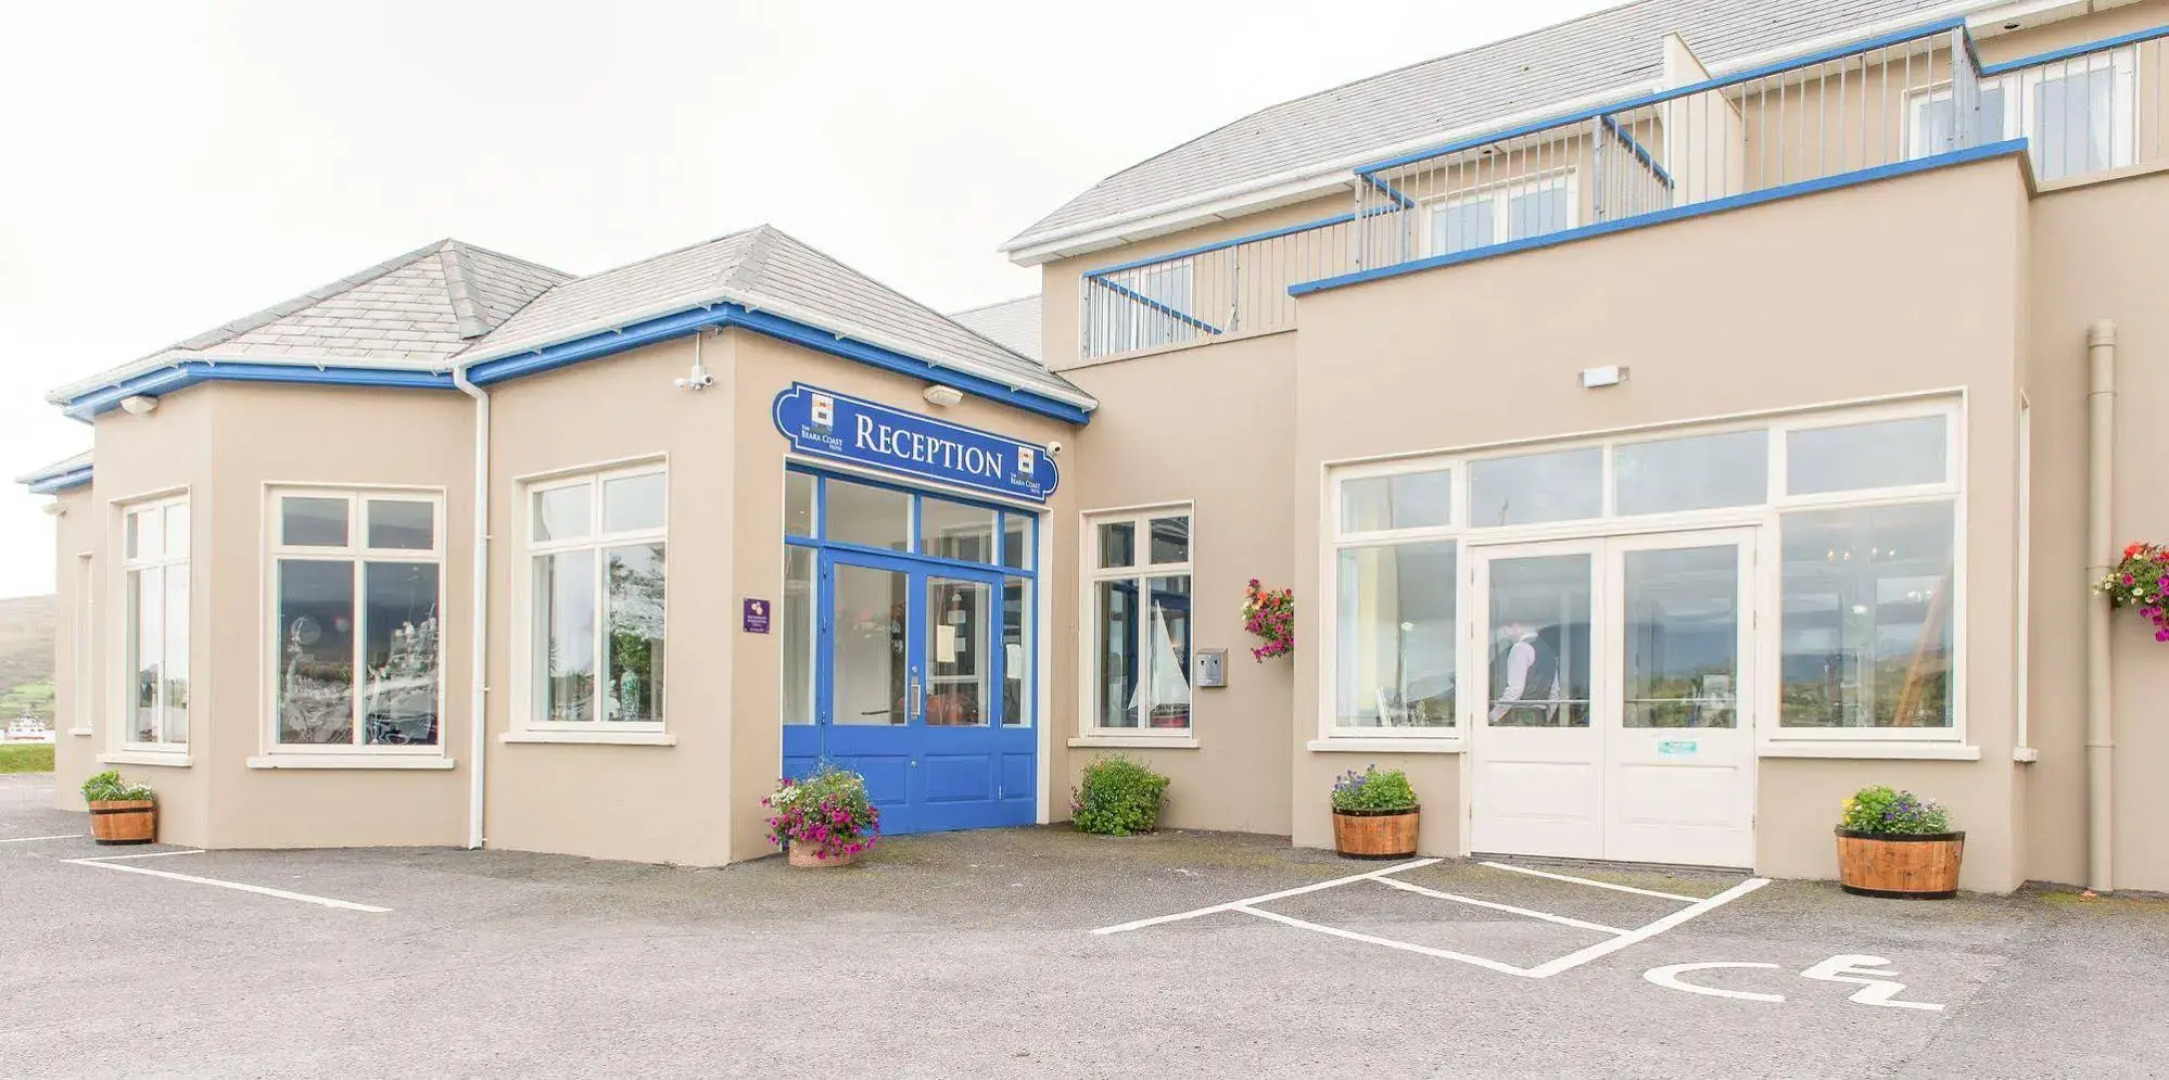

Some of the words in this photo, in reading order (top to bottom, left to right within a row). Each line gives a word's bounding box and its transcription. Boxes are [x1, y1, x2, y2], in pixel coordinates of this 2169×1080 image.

[801, 430, 822, 442] BEARA
[822, 434, 842, 446] COAST
[855, 413, 1003, 480] RECEPTION
